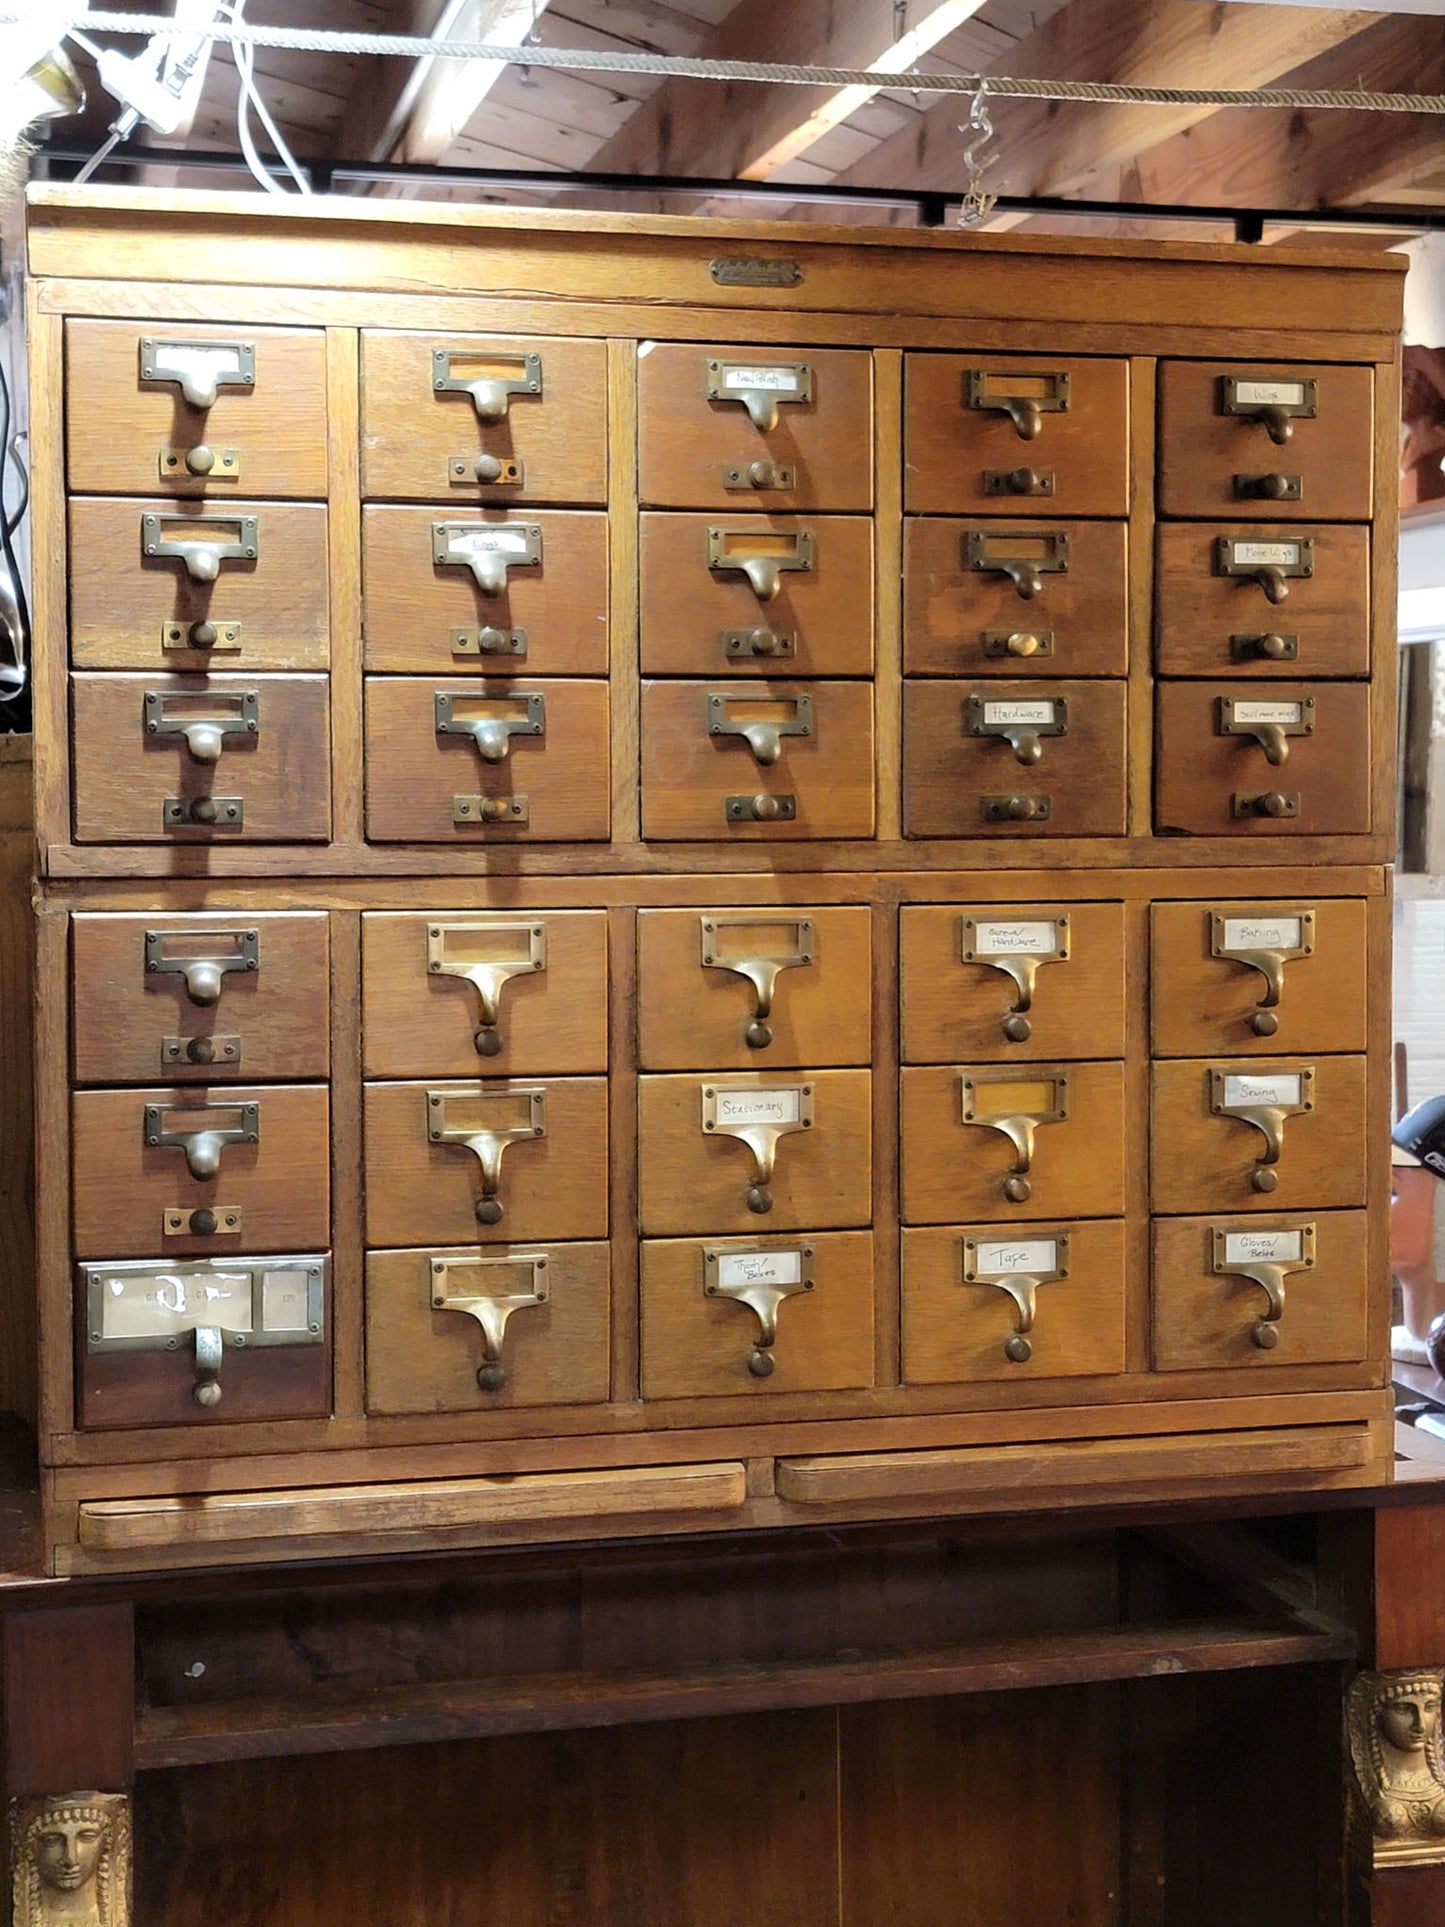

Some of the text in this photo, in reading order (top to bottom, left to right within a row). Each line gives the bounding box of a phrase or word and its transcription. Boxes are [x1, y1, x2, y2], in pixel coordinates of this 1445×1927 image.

[993, 705, 1044, 720] Hardware
[992, 936, 1040, 947] Hardware
[1240, 925, 1281, 944] Baking
[1240, 1084, 1278, 1103] Sewing
[722, 1100, 784, 1119] Stationary
[1240, 1236, 1280, 1247] Gloves/
[989, 1248, 1030, 1267] Tape
